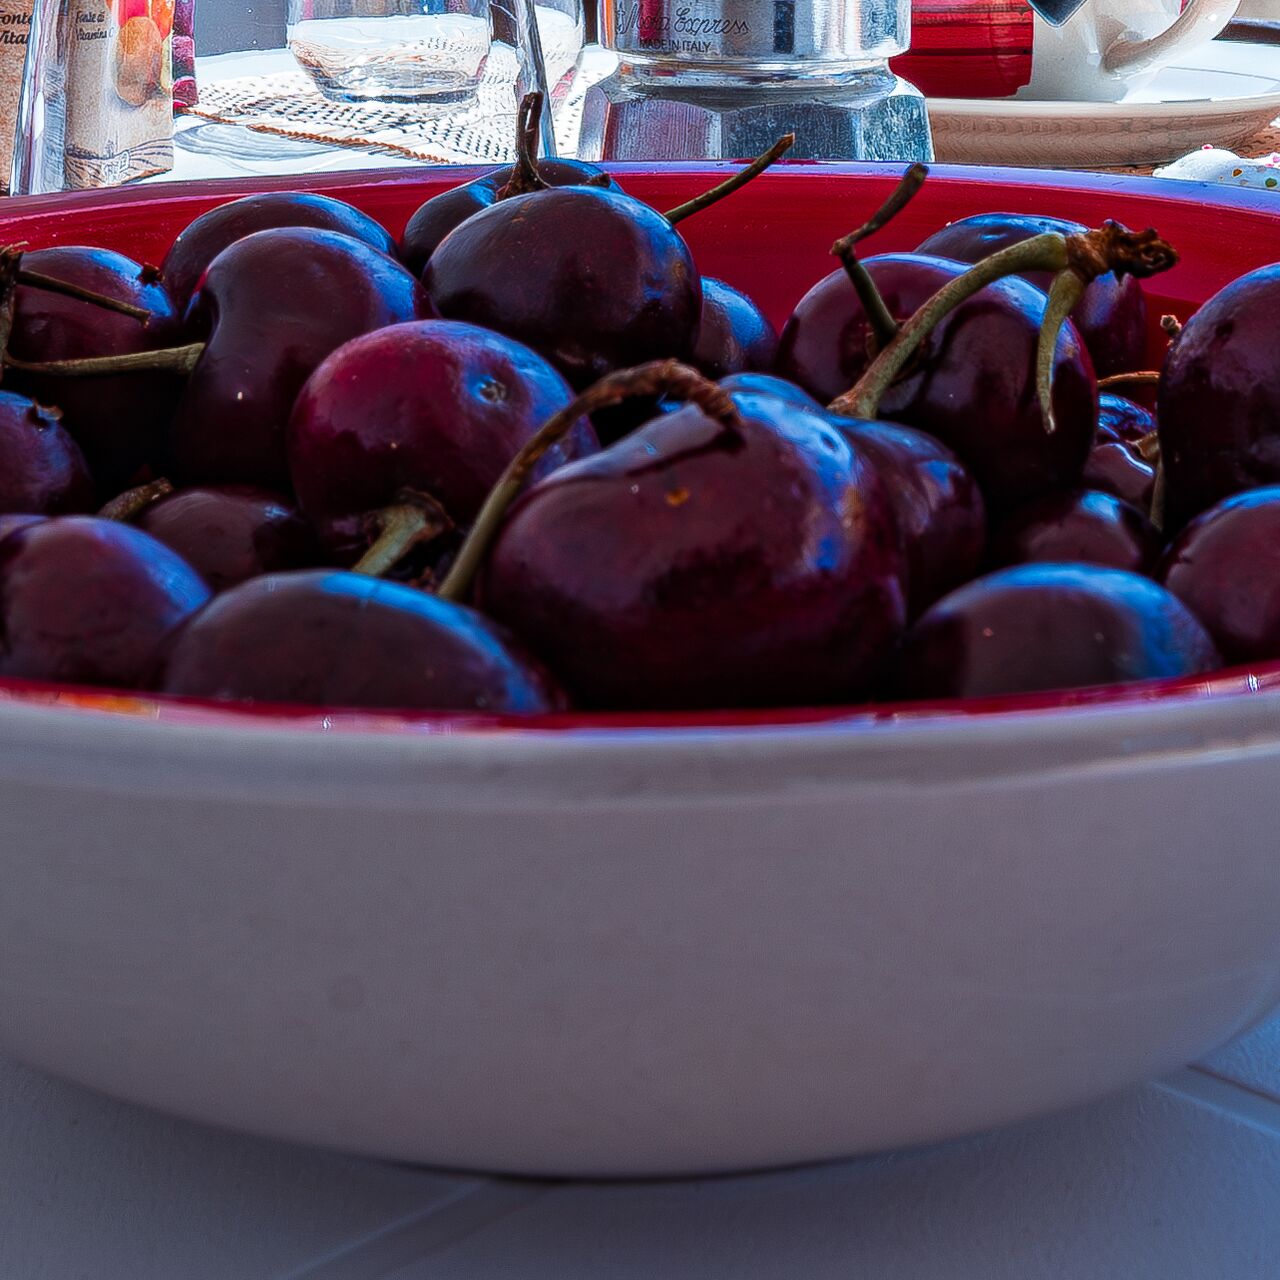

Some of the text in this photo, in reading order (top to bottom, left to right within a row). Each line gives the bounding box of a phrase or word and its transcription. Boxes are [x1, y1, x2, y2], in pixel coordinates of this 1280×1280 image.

[674, 7, 749, 36] Express
[640, 38, 711, 52] MADE IN ITALY
